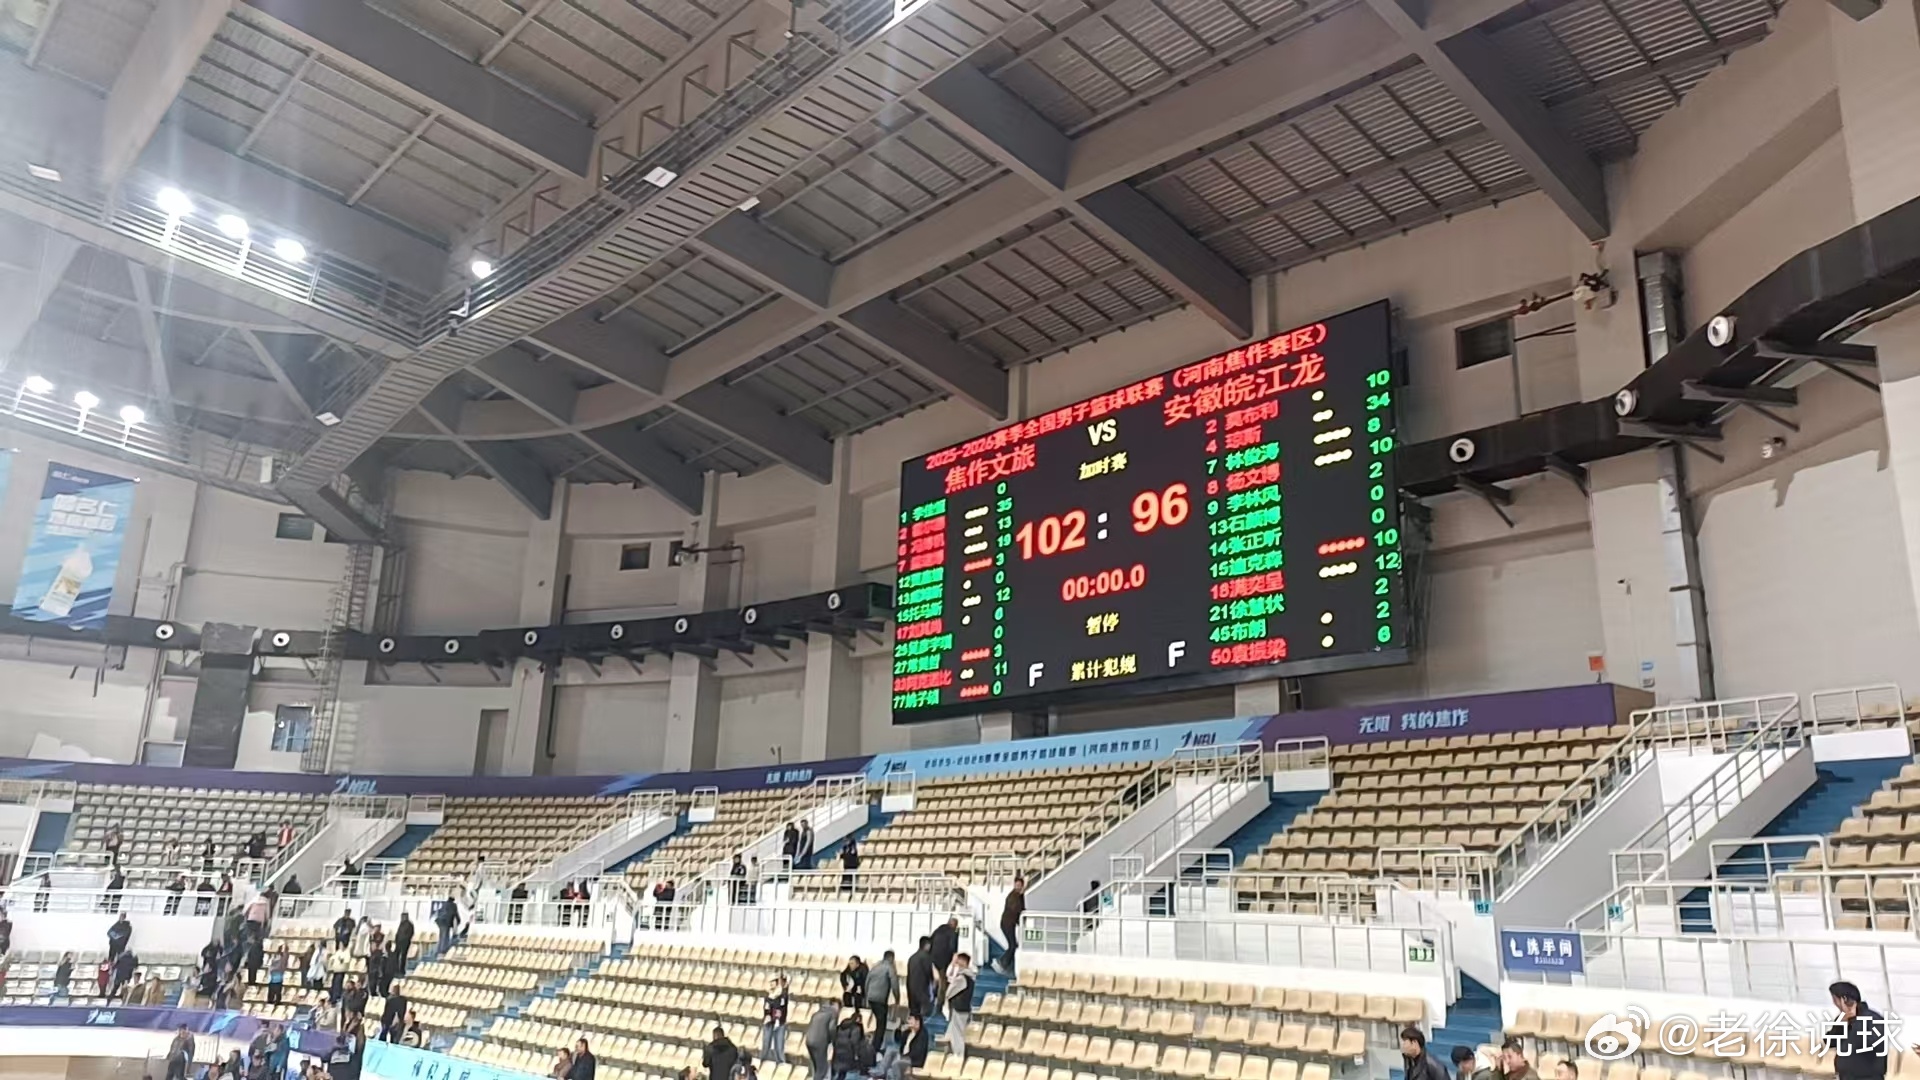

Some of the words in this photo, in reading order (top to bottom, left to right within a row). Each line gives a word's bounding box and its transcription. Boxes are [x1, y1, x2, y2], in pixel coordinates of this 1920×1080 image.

[1164, 353, 1326, 425] 安徽皖江龙
[1206, 419, 1217, 434] 2
[1366, 370, 1390, 388] 10
[1206, 439, 1217, 453] 4
[1366, 392, 1390, 410] 34
[1088, 419, 1117, 446] VS
[1206, 459, 1217, 474] 7
[1367, 417, 1380, 432] 8
[945, 443, 1036, 494] 焦作文旅
[1079, 452, 1128, 480] 加时赛
[1207, 480, 1218, 494] 8
[1369, 436, 1393, 454] 10
[1207, 501, 1218, 515] 9
[1369, 461, 1383, 478] 2
[1370, 485, 1384, 500] 0
[901, 511, 907, 523] 1
[997, 482, 1006, 494] 0
[997, 497, 1012, 512] 35
[997, 516, 1011, 530] 13
[1016, 510, 1086, 560] 102
[1132, 484, 1189, 533] 96
[1371, 507, 1385, 523] 0
[997, 533, 1011, 547] 19
[1374, 528, 1397, 546] 10
[996, 553, 1004, 565] 3
[1375, 552, 1399, 570] 12
[995, 571, 1004, 584] 0
[1062, 564, 1145, 601] 00:00.0
[1375, 577, 1389, 595] 2
[996, 588, 1010, 602] 12
[1376, 601, 1389, 618] 2
[994, 626, 1003, 639] 0
[1086, 612, 1119, 635] 暂停
[1377, 625, 1391, 642] 6
[994, 644, 1002, 657] 3
[994, 661, 1008, 676] 11
[1029, 663, 1044, 687] F
[1168, 641, 1186, 667] F
[993, 681, 1001, 695] 0
[1526, 938, 1573, 957] 洗手间
